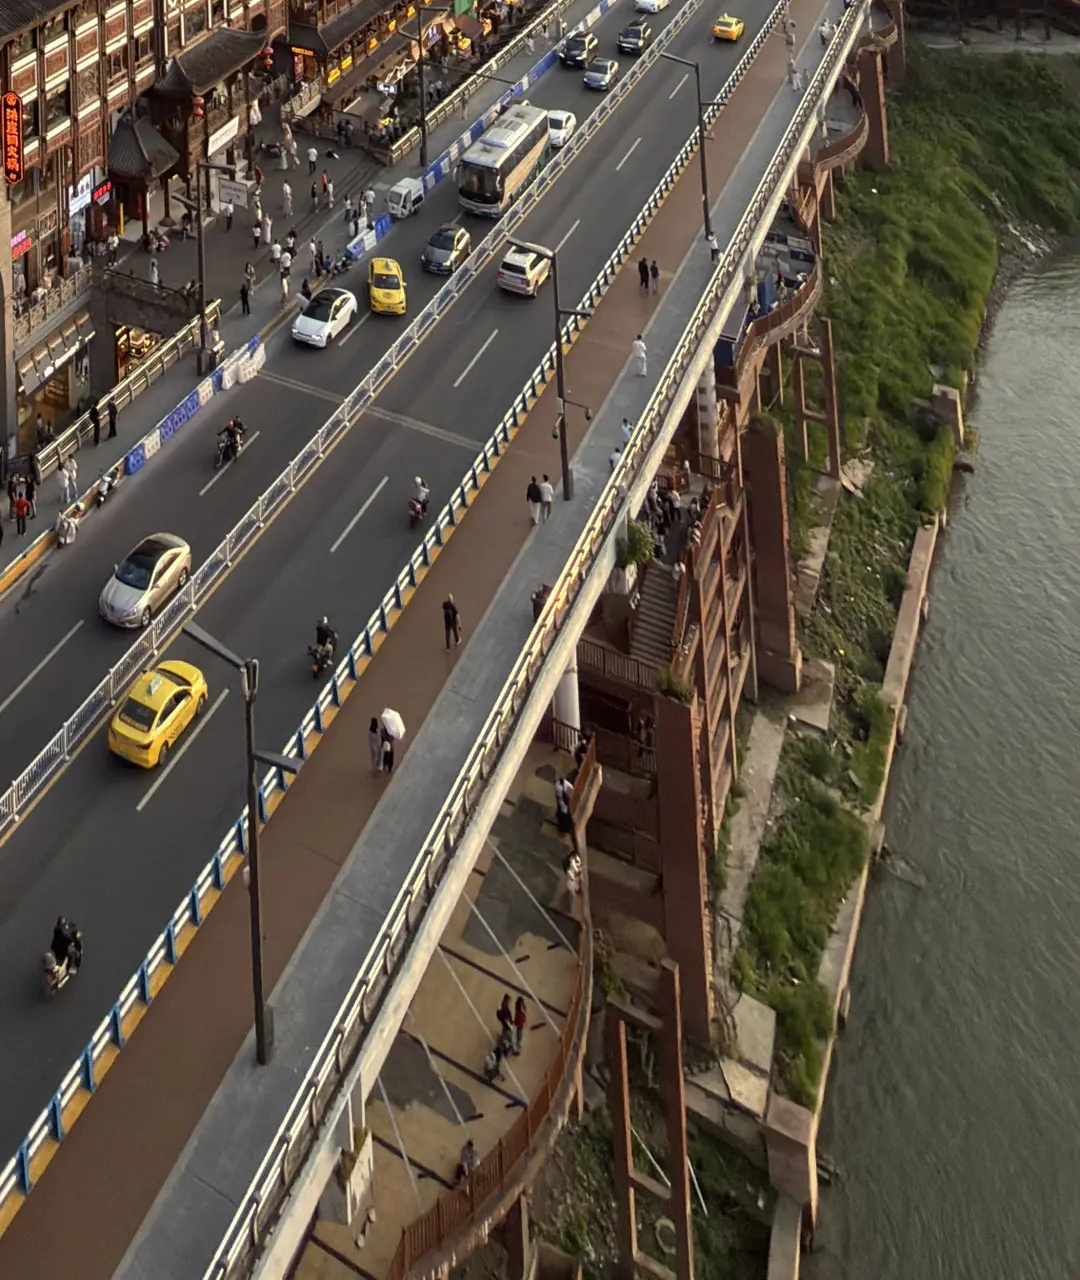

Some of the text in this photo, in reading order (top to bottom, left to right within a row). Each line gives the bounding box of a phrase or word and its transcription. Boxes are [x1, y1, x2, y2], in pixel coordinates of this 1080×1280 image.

[6, 108, 20, 172] 洪崖洞火锅
